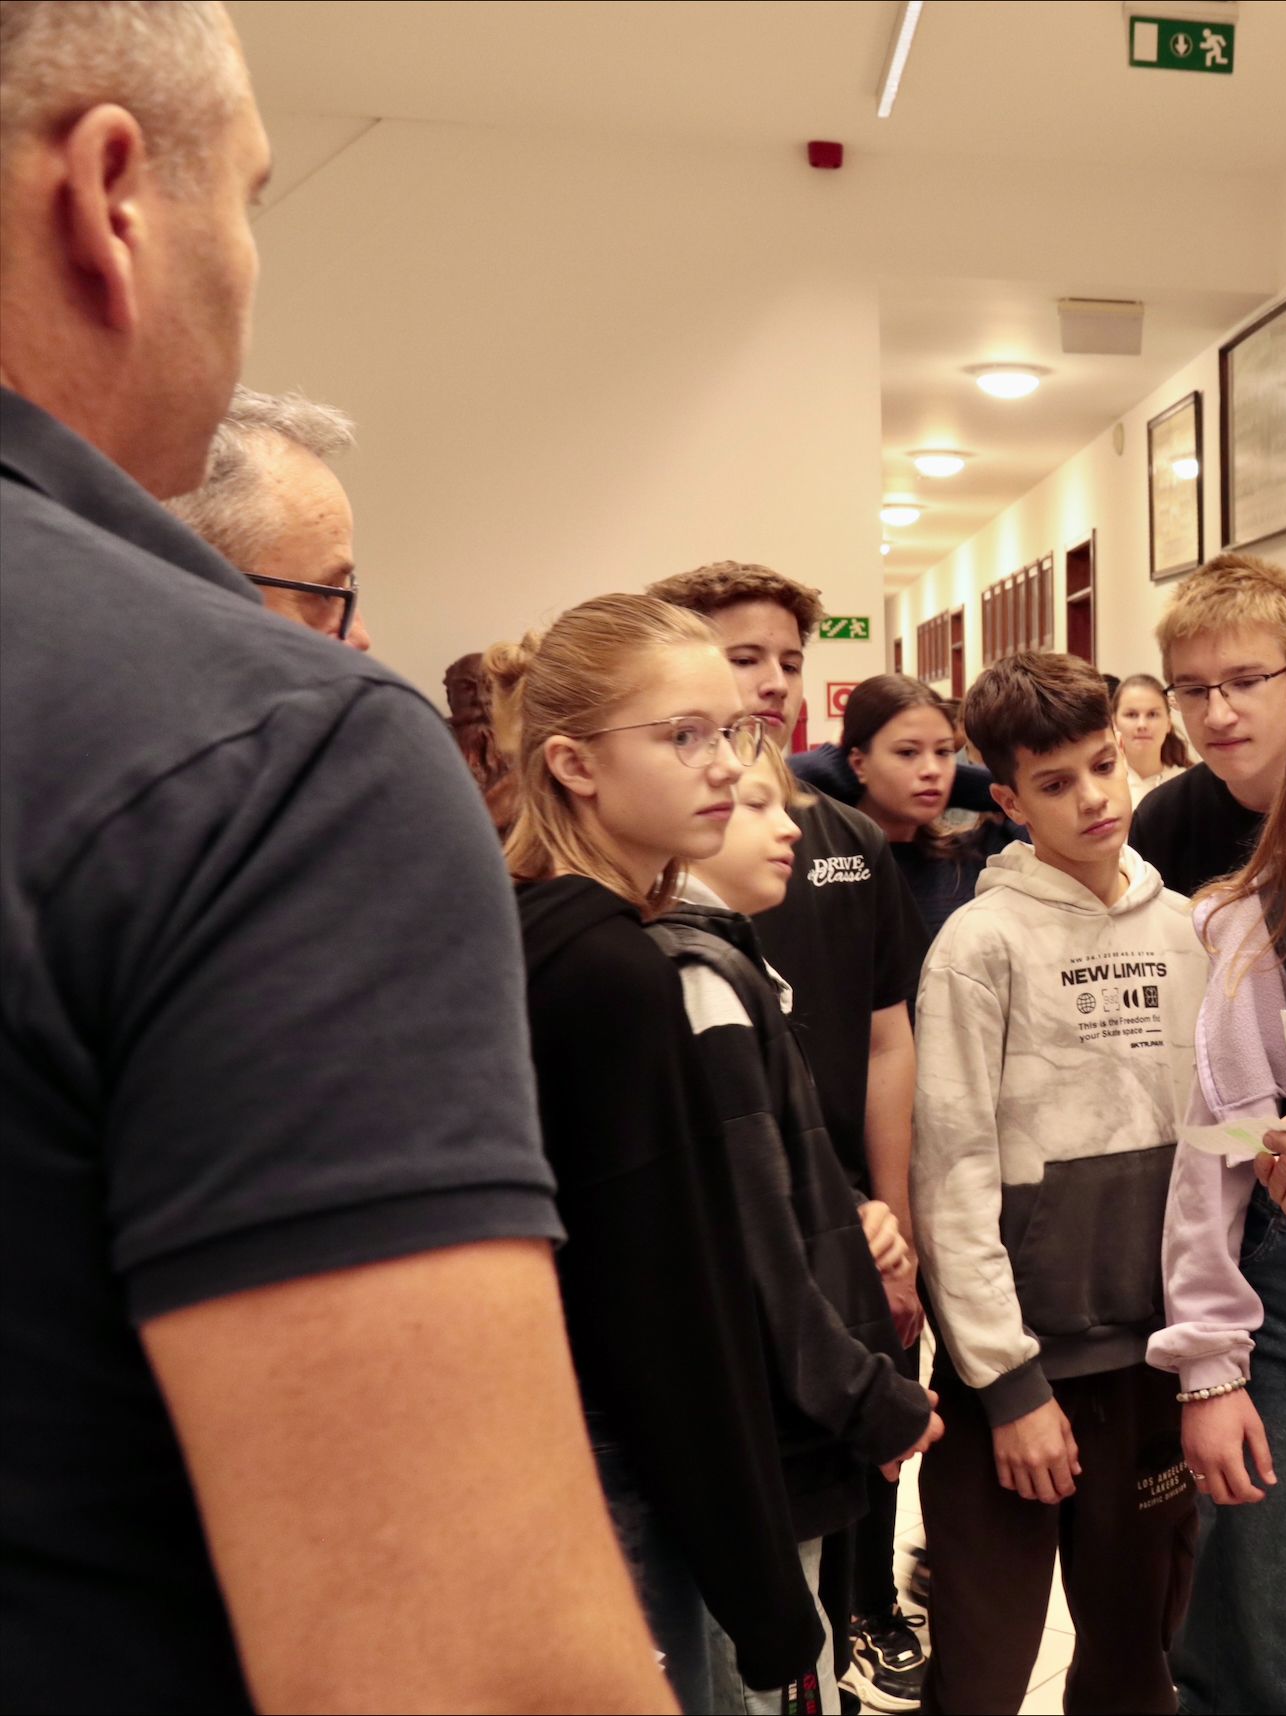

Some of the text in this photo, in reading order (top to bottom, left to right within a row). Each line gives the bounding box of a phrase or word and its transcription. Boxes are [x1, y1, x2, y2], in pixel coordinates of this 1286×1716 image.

[813, 855, 864, 870] DRIVE
[812, 868, 871, 887] Classic
[1061, 962, 1167, 986] NEW LIMITS
[1078, 1022, 1097, 1031] This
[1099, 1020, 1106, 1028] is
[1108, 1018, 1118, 1026] the
[1119, 1016, 1150, 1025] Freedom
[1079, 1028, 1143, 1044] your Skate space
[1137, 1461, 1188, 1490] LOS ANGELES
[1151, 1475, 1179, 1495] LAKERS
[1139, 1496, 1163, 1510] PACIFIC
